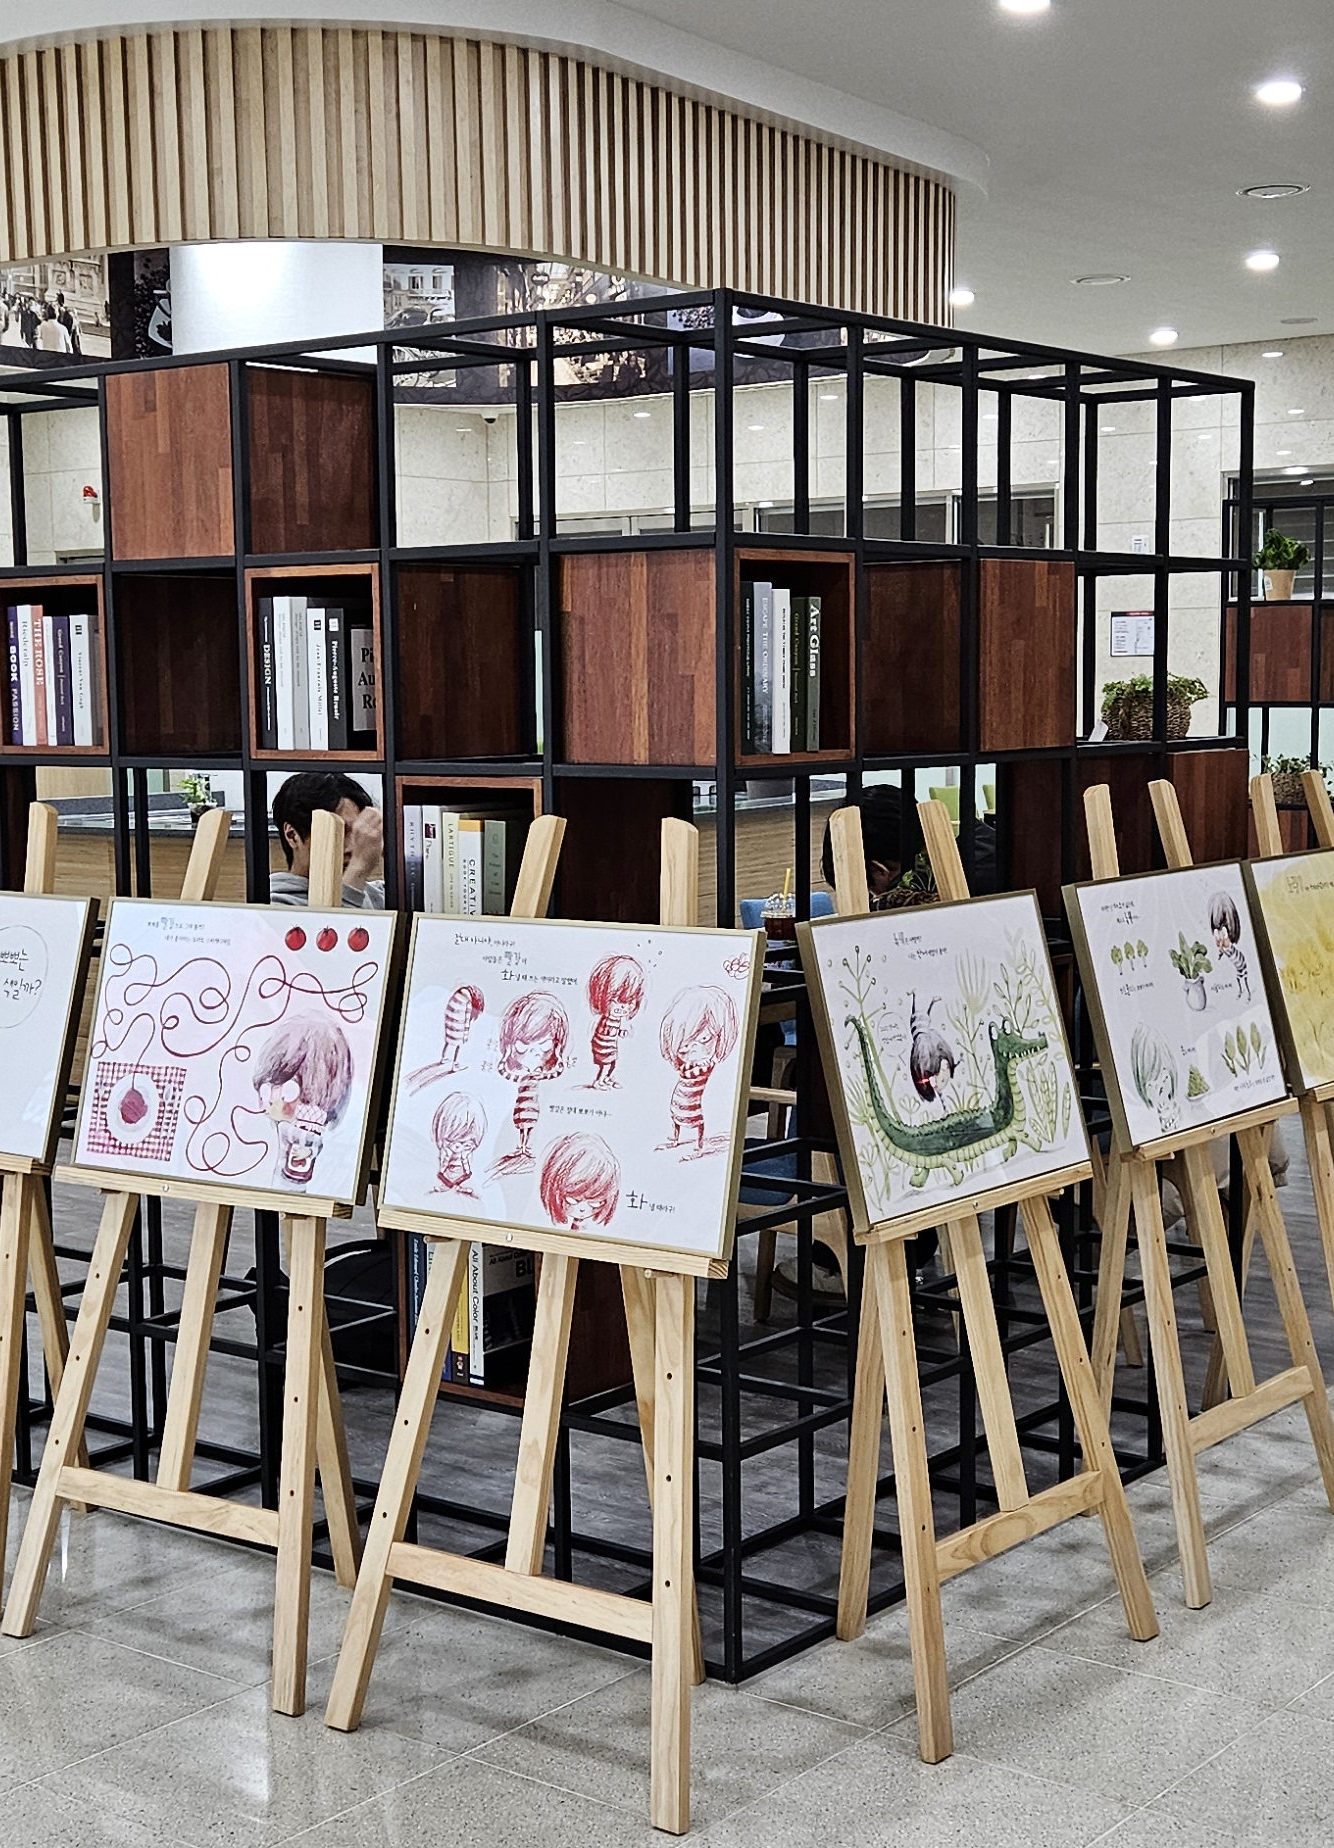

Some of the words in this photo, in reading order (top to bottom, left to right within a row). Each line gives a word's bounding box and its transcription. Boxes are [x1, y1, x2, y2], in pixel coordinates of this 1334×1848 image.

[809, 603, 820, 632] Art
[33, 619, 42, 647] THE
[761, 631, 769, 649] THE
[9, 644, 19, 682] BOOK
[35, 649, 44, 686] ROSE
[263, 643, 272, 686] DESIGN
[808, 634, 820, 677] Glass
[10, 688, 20, 731] PASSION
[3, 979, 42, 1000] 색일까?
[471, 1248, 479, 1263] All
[471, 1264, 479, 1294] About
[472, 1295, 480, 1323] Color
